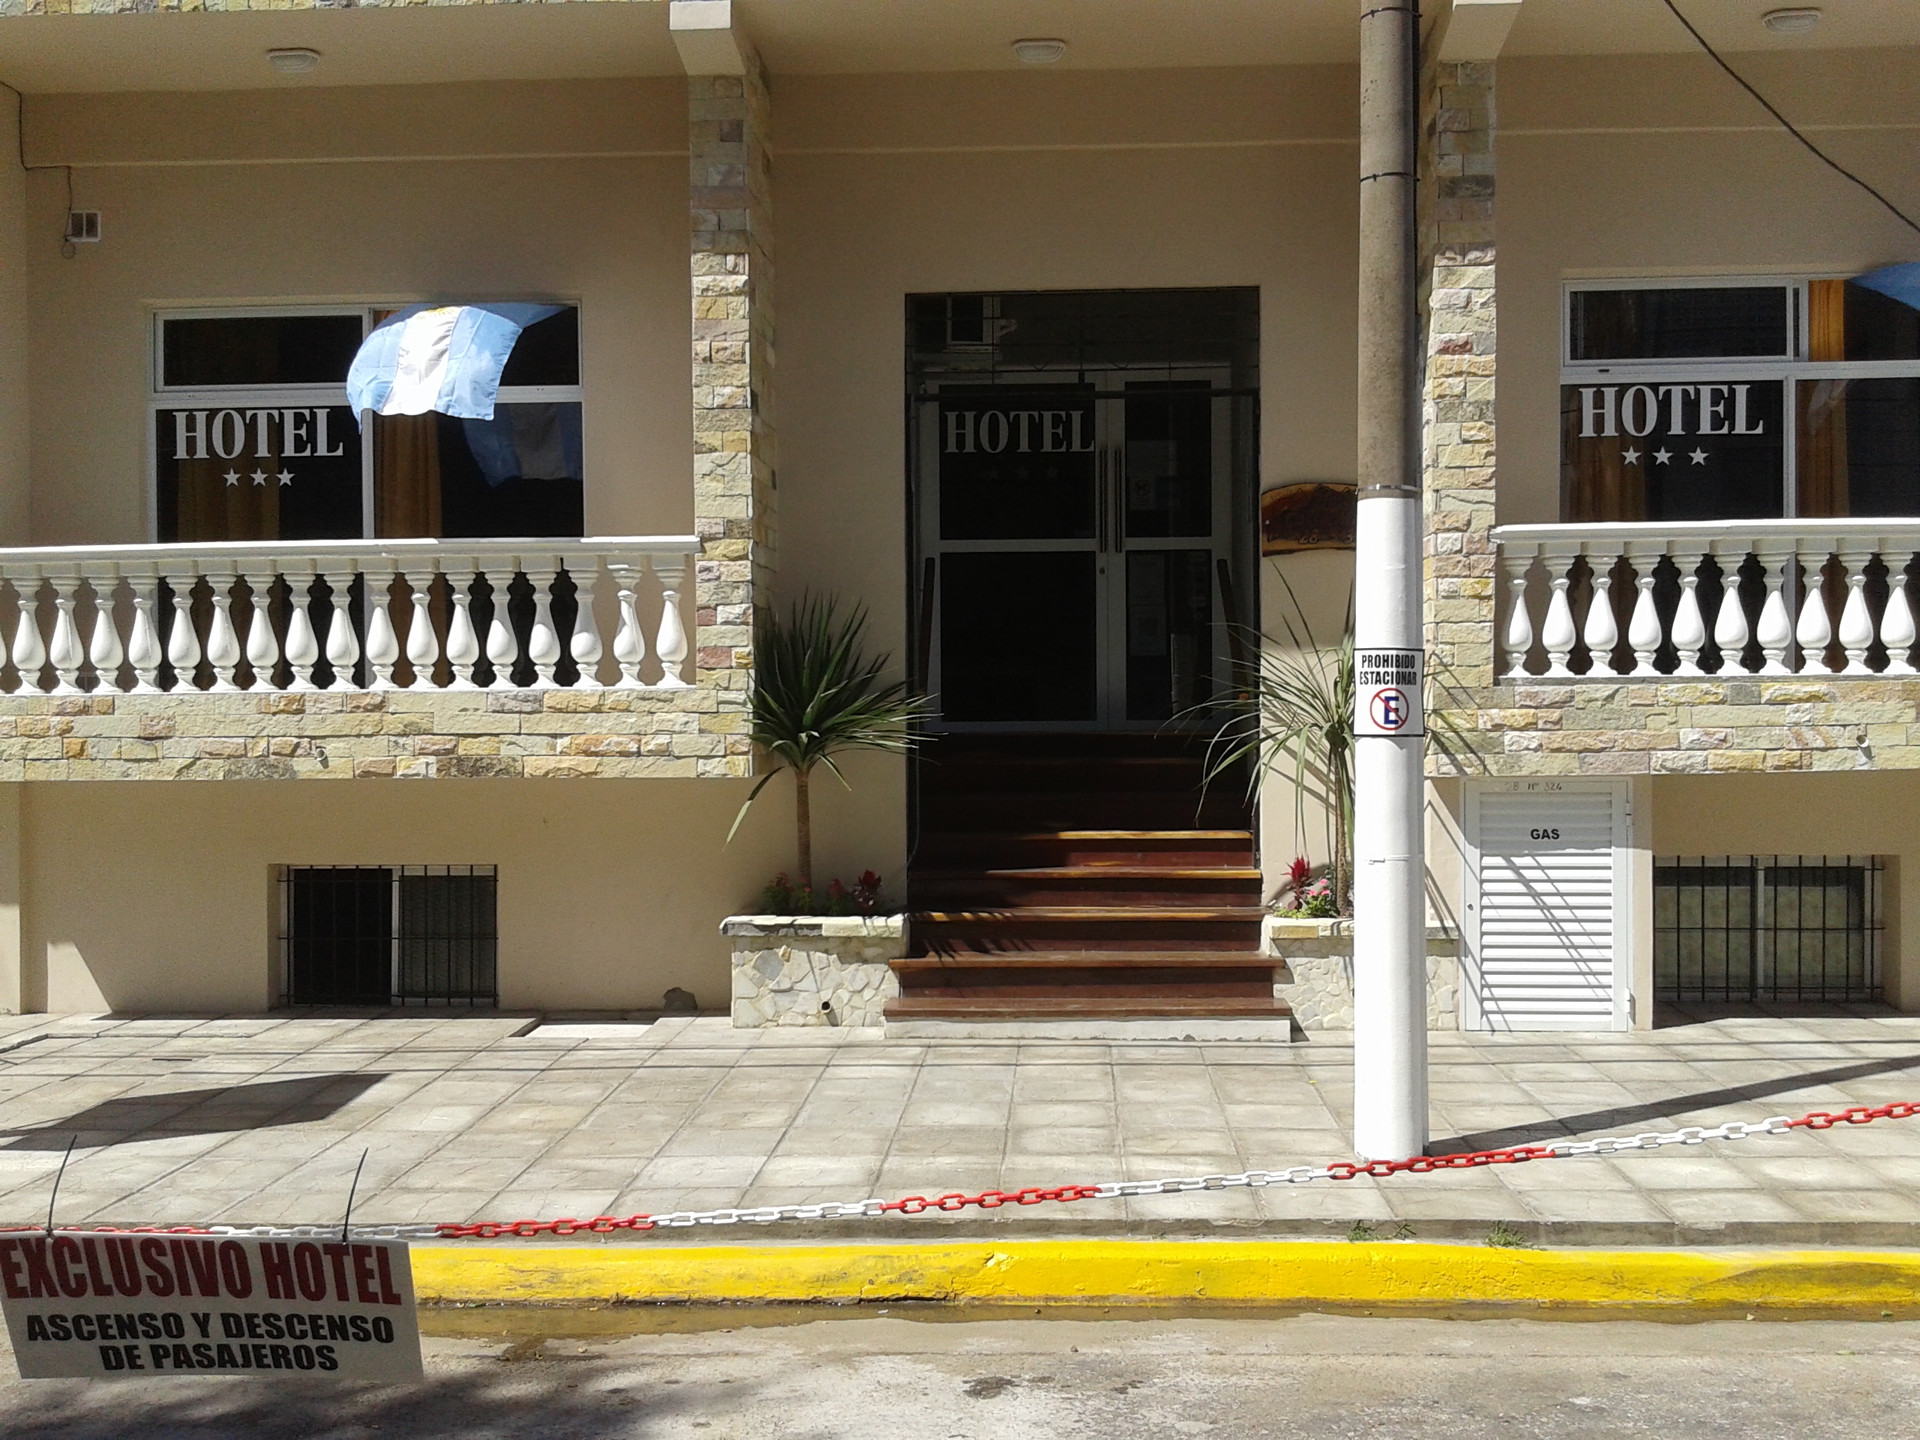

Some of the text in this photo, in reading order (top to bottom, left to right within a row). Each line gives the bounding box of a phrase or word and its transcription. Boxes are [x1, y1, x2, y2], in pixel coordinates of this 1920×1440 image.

[1578, 384, 1764, 437] HOTEL
[172, 408, 344, 459] HOTEL
[944, 410, 1095, 453] HOTEL
[1361, 654, 1416, 669] PROHIBIDO
[1359, 670, 1417, 686] ESTACIONAR
[1383, 696, 1400, 725] E
[1530, 828, 1560, 840] GAS
[0, 1236, 402, 1306] EXCLUSIVO HOTEL
[26, 1312, 395, 1344] ASCENSO Y DESCENSO
[99, 1344, 339, 1372] DE PASAJEROS
